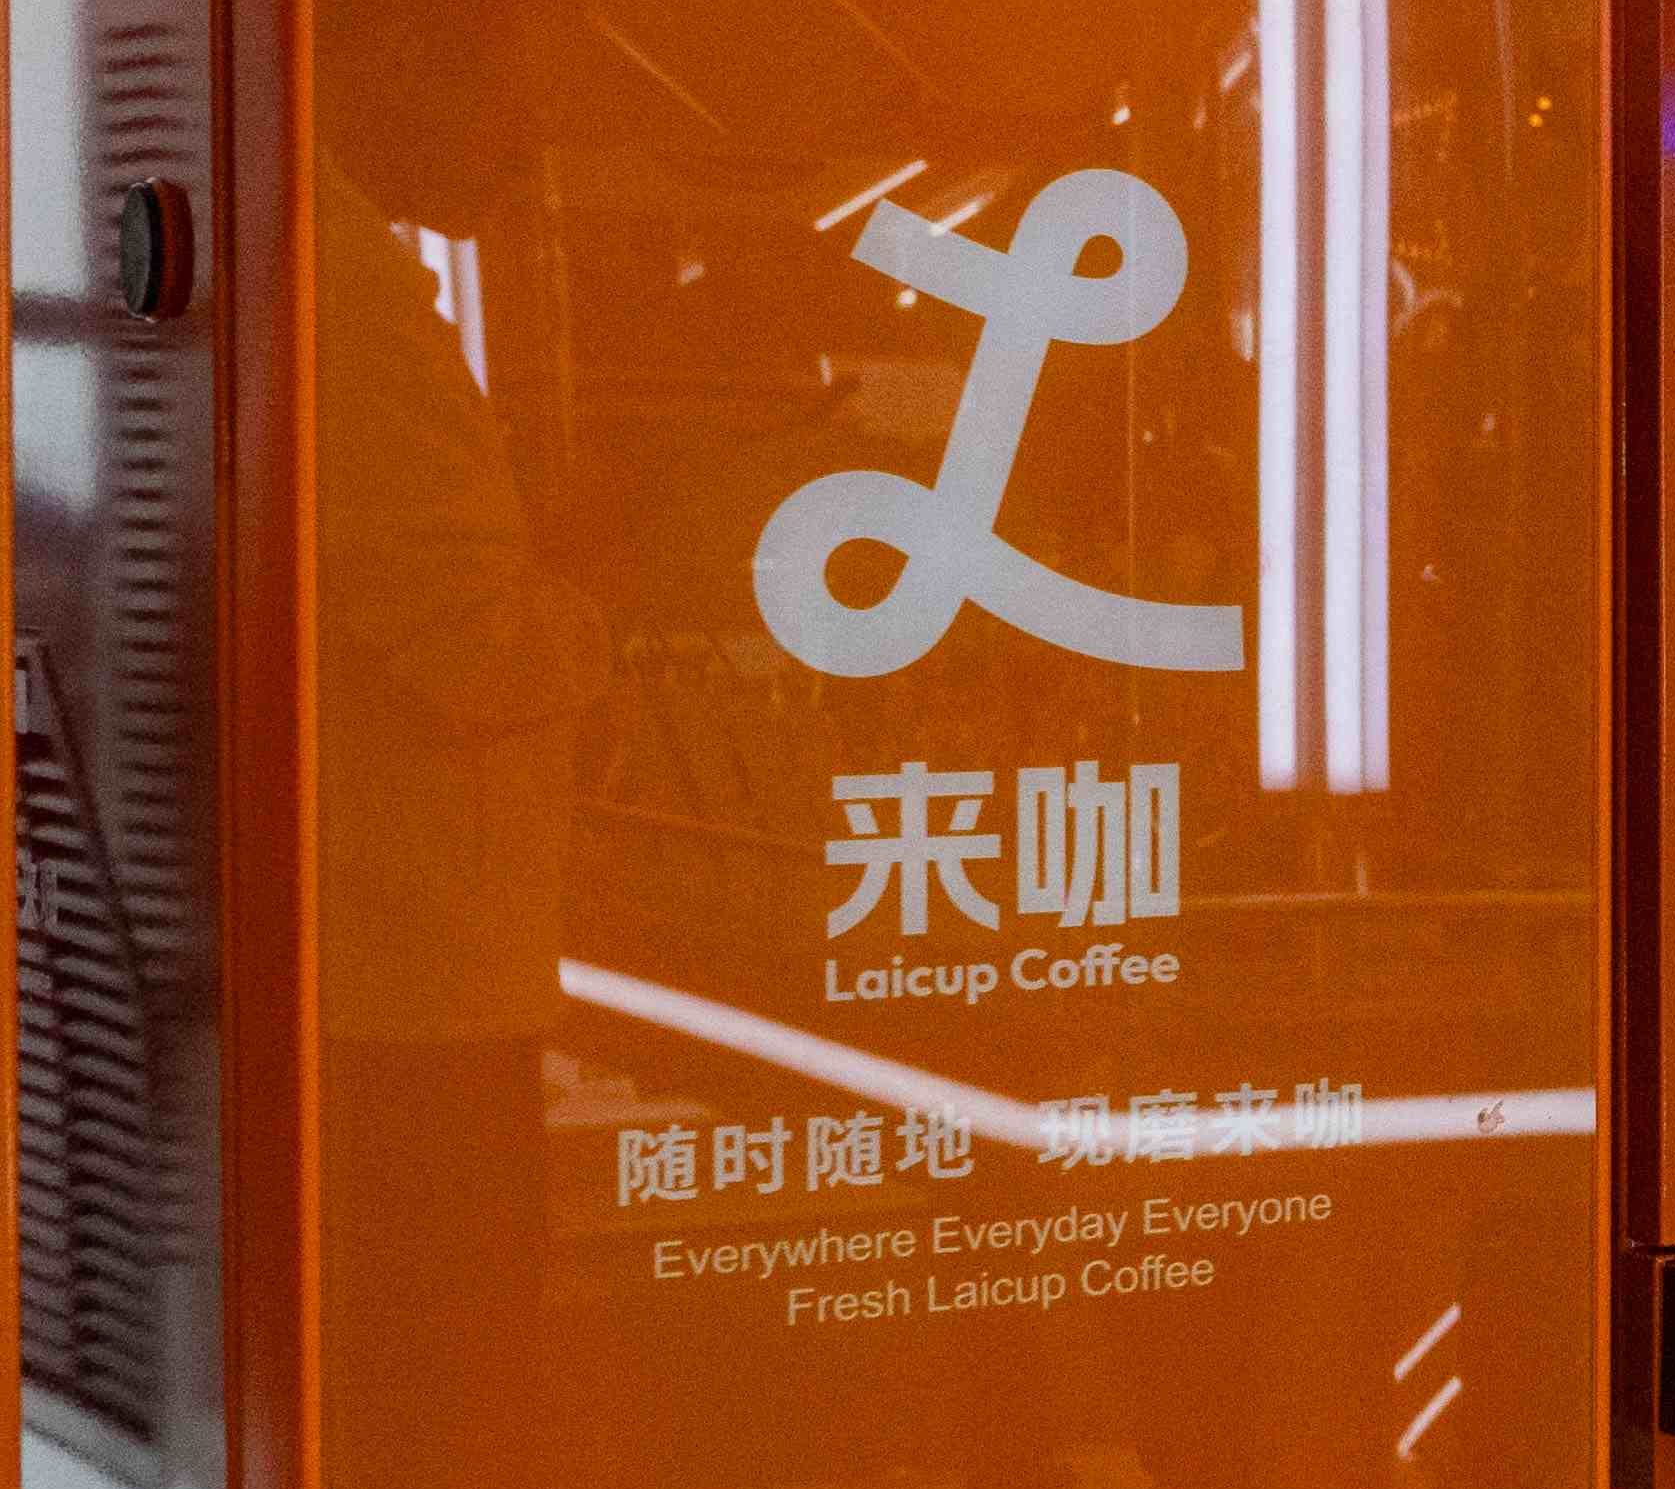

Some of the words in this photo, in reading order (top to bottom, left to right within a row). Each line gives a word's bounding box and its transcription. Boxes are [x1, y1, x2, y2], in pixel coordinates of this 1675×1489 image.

[825, 761, 1181, 940] 来咖
[825, 956, 999, 1005] Laicup
[1010, 944, 1181, 991] Coffee
[617, 1109, 975, 1208] 随时随地
[653, 1227, 916, 1280] Everywhere
[932, 1205, 1129, 1255] Everyday
[1142, 1194, 1333, 1237] Everyone
[786, 1279, 911, 1327] Fresh
[927, 1271, 1067, 1312] Laicup
[1081, 1254, 1216, 1297] Coffee
